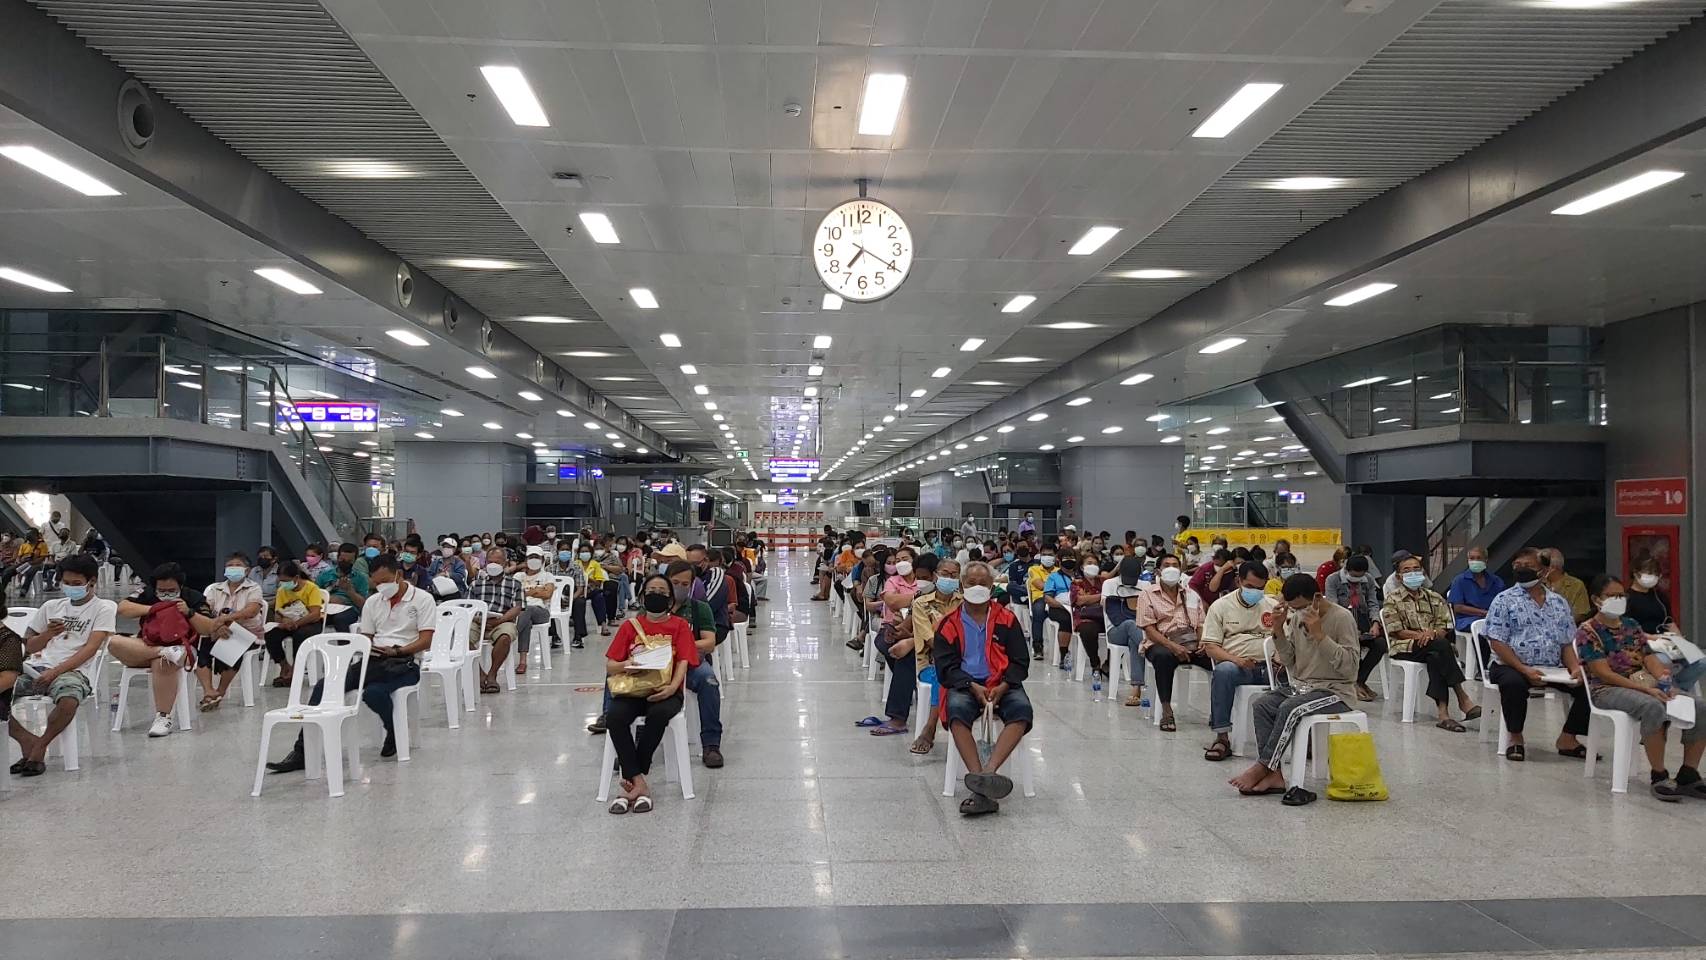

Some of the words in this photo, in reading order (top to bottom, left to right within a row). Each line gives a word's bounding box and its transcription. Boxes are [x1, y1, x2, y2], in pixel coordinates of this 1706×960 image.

[843, 213, 853, 227] 11
[857, 210, 872, 224] 12
[828, 226, 842, 240] 10
[887, 225, 897, 239] 2
[823, 243, 834, 257] 9
[892, 242, 902, 257] 3
[829, 259, 840, 274] 8
[886, 260, 896, 272] 4
[843, 272, 852, 285] 7
[857, 275, 868, 290] 6
[874, 271, 885, 285] 5
